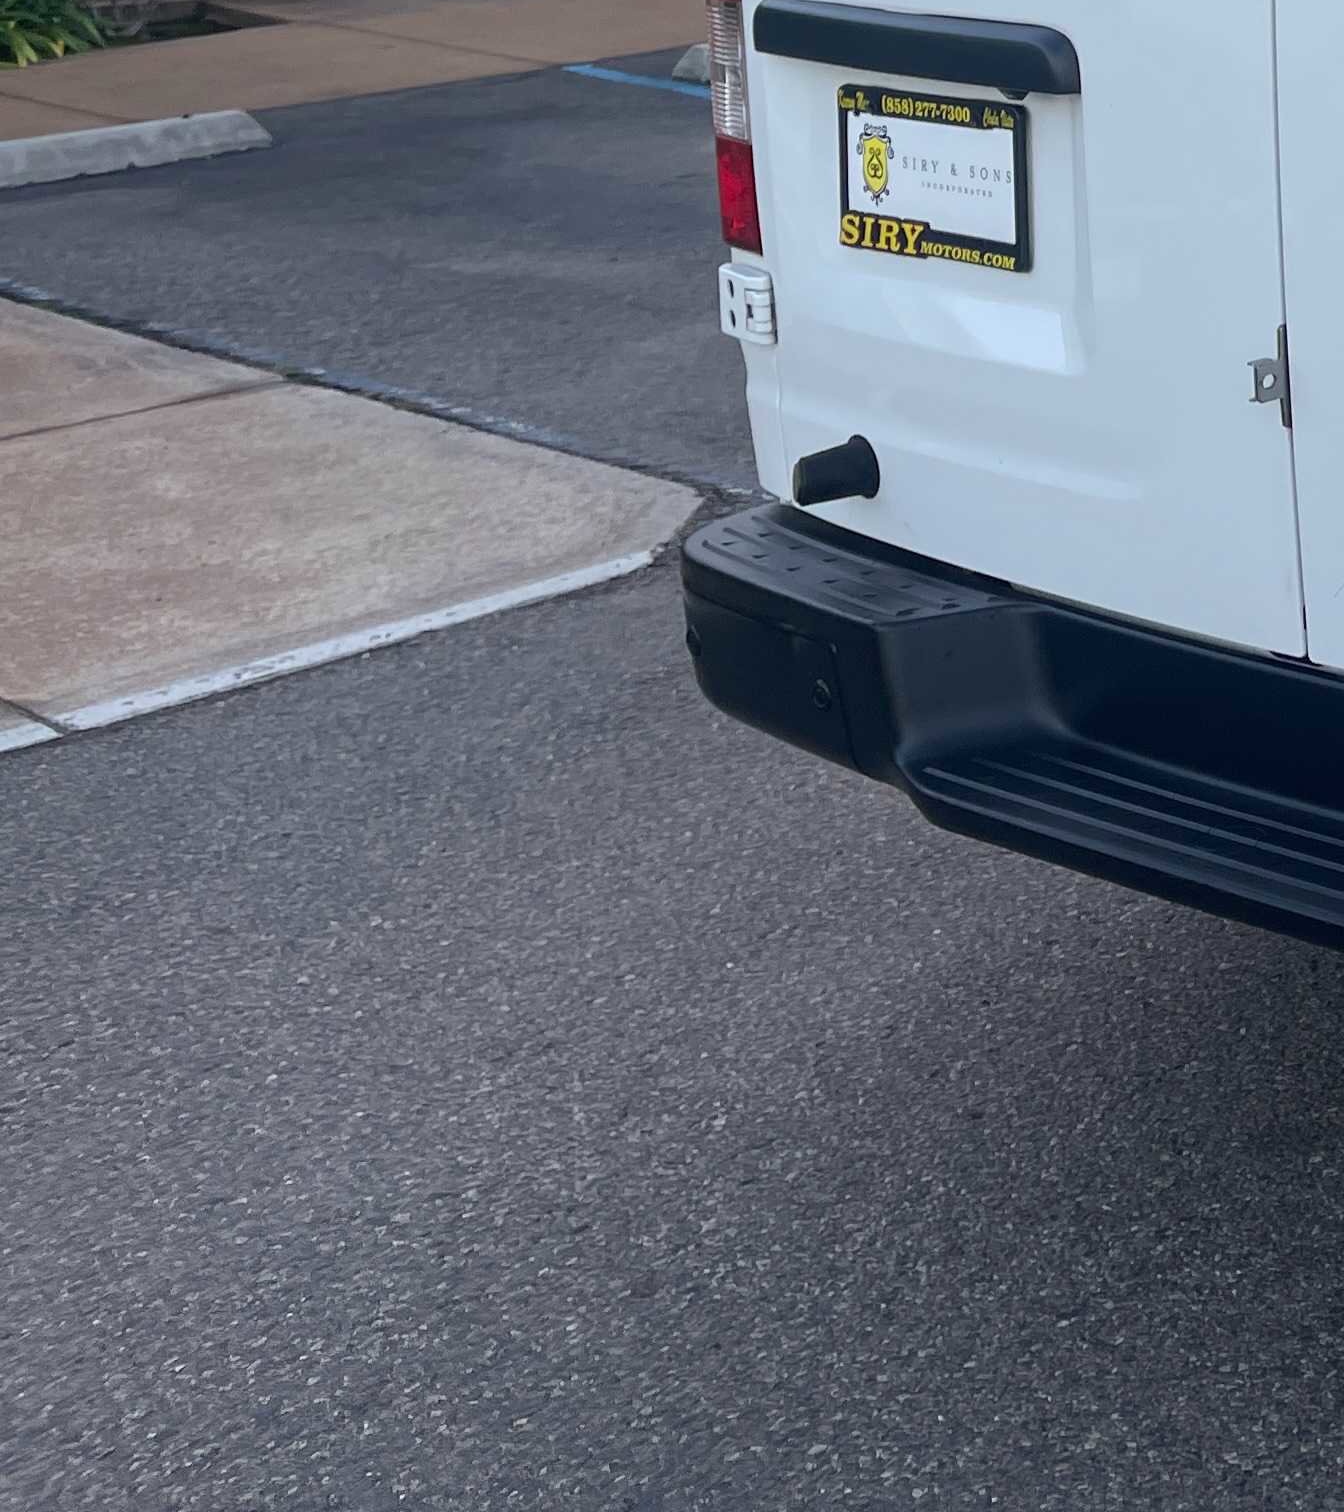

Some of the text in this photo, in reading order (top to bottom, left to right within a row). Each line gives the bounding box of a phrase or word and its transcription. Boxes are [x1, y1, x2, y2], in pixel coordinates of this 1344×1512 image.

[902, 155, 1012, 184] SIRY & SONS
